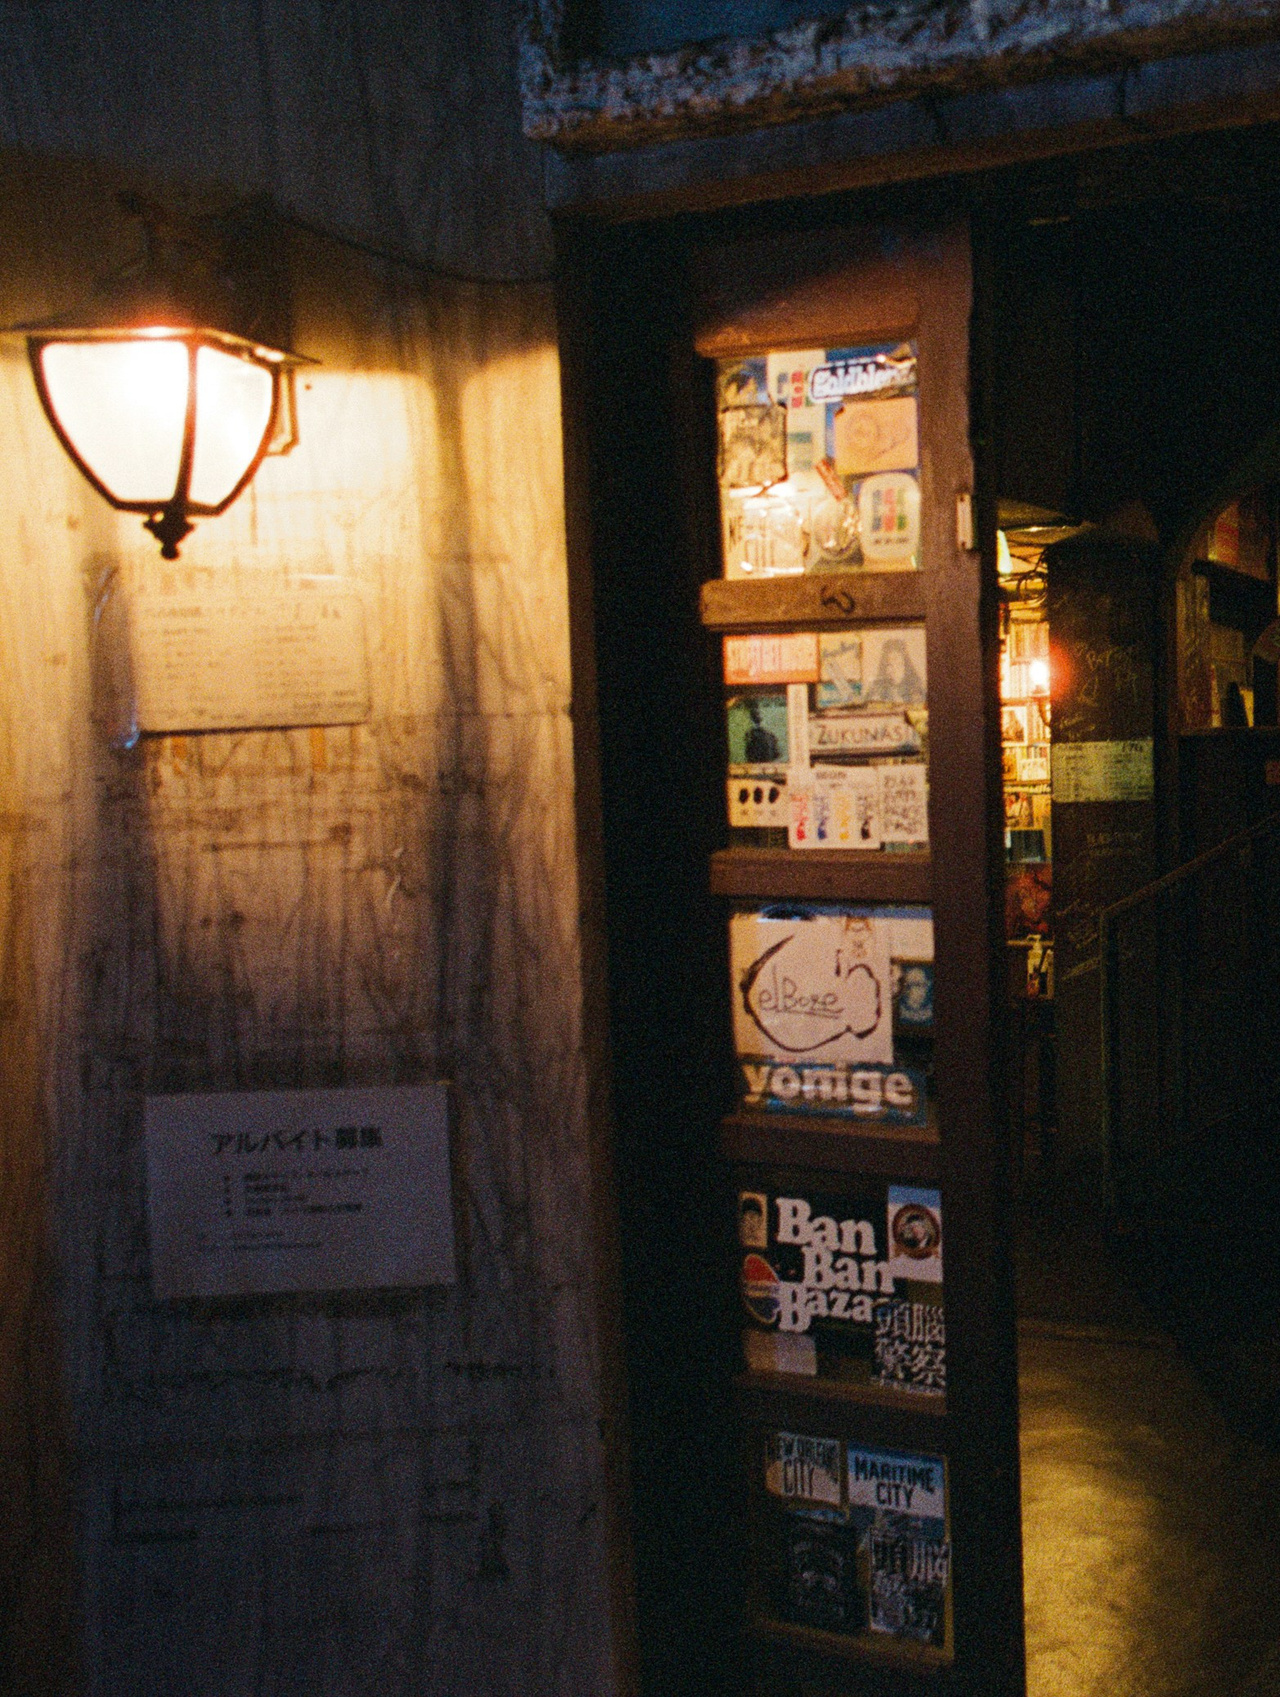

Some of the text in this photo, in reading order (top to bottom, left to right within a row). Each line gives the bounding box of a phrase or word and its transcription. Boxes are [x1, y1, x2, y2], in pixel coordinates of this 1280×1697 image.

[776, 1197, 876, 1255] Ban
[801, 1247, 895, 1294] Ban
[778, 1281, 892, 1332] Baza
[854, 1454, 936, 1494] MARITIME
[876, 1482, 916, 1508] CITY
